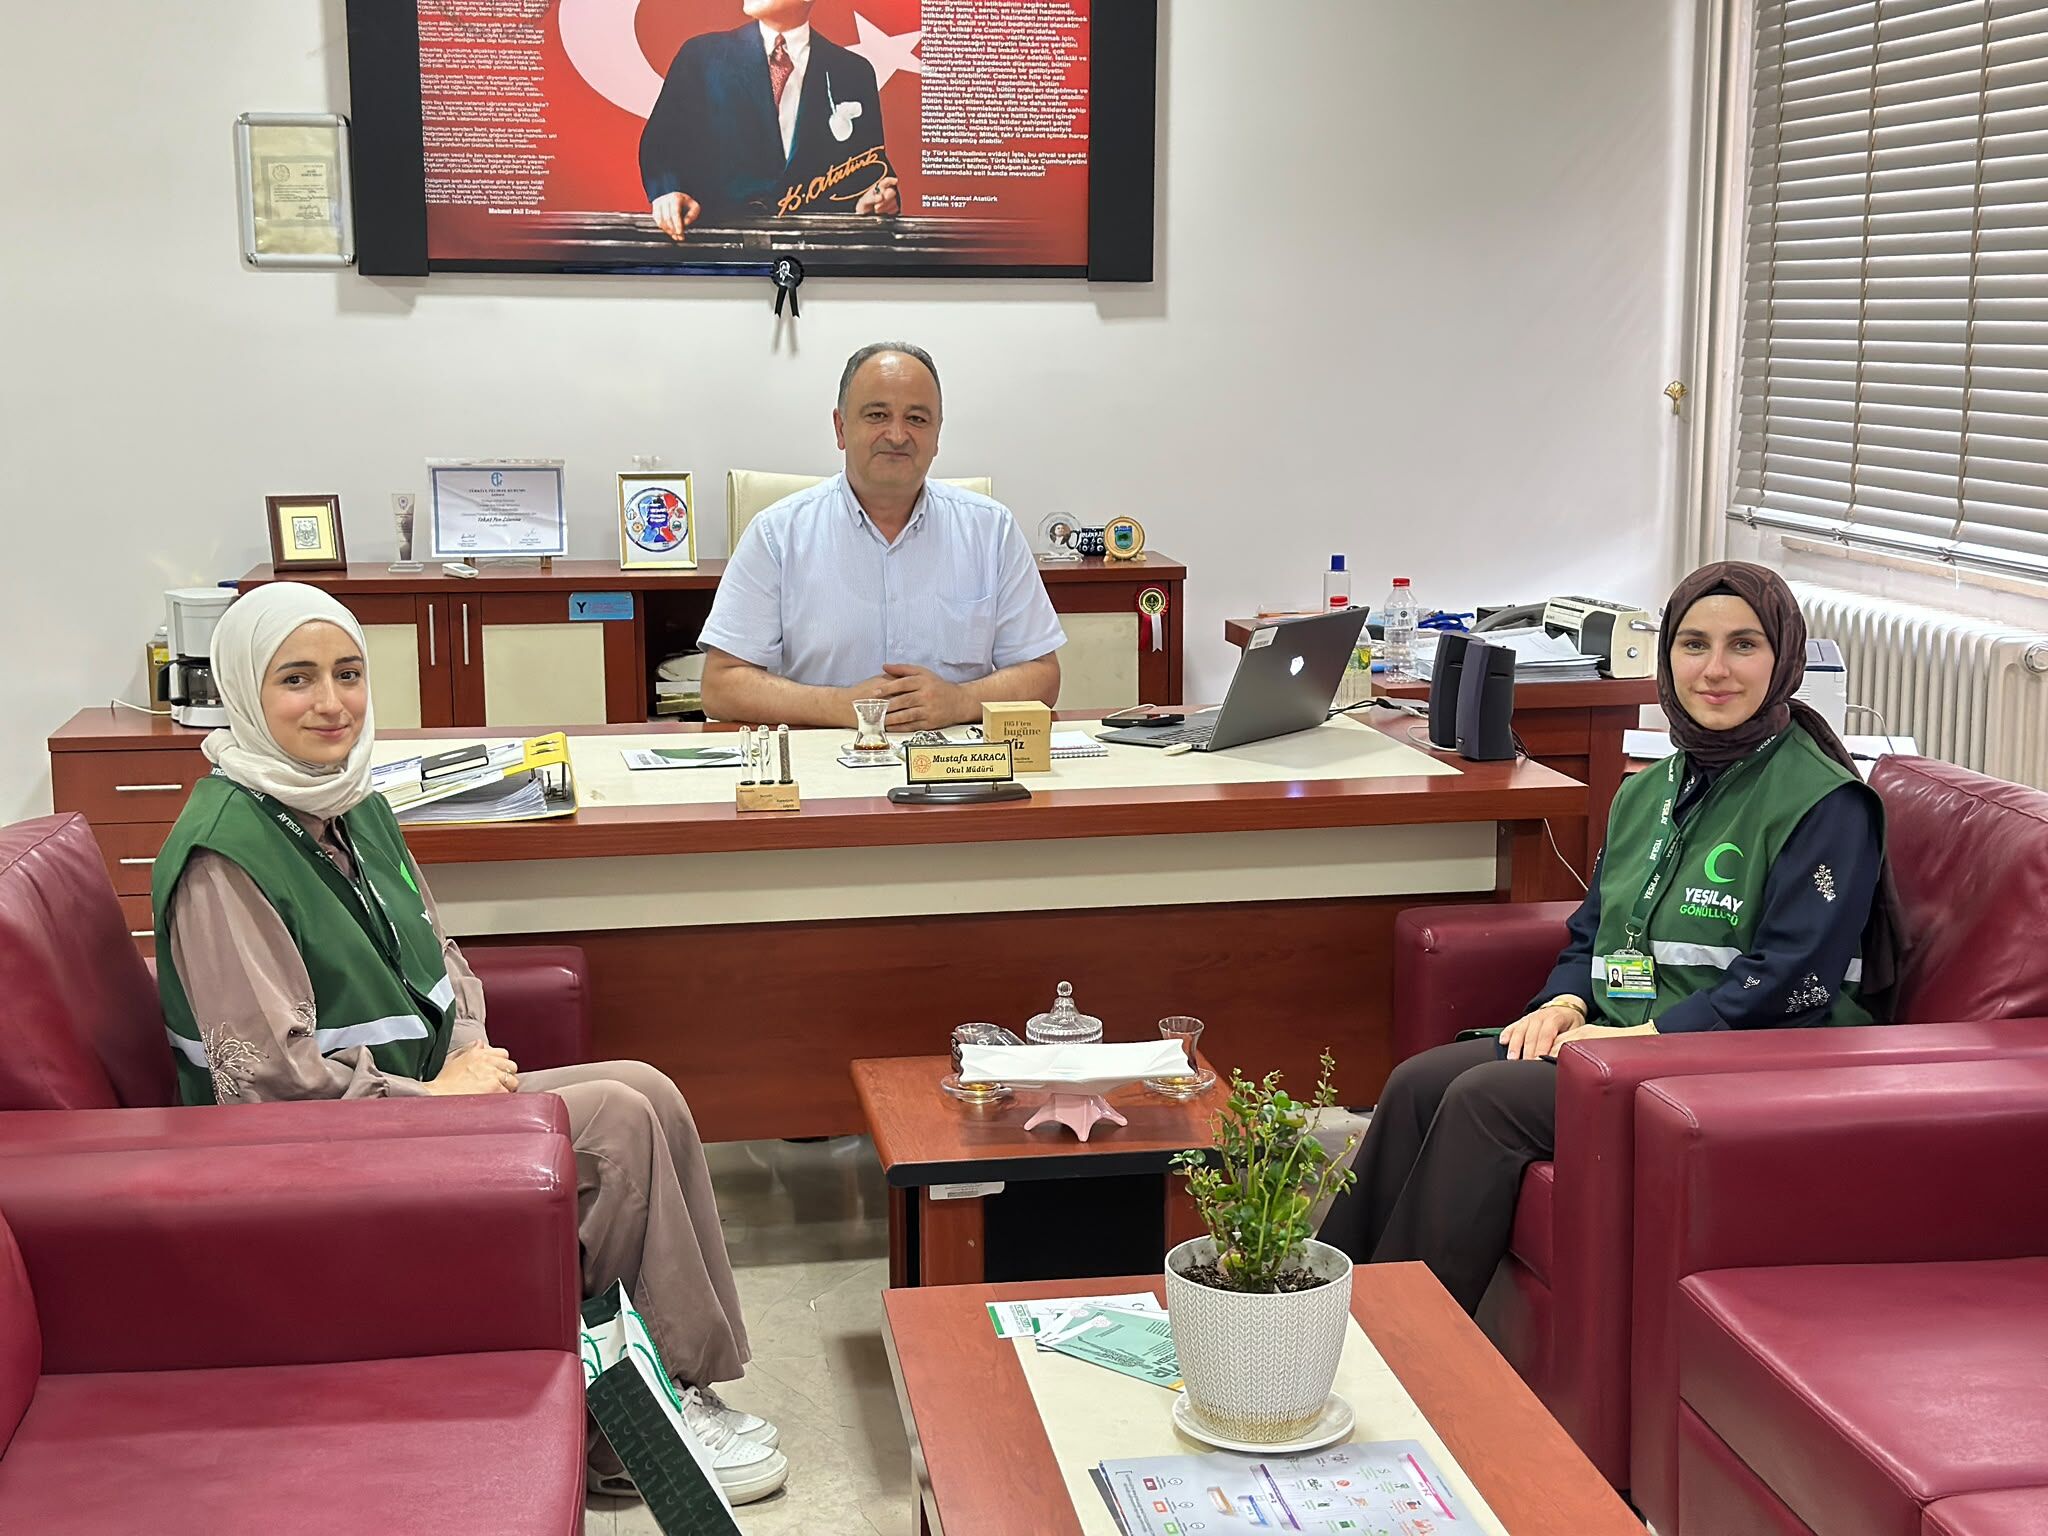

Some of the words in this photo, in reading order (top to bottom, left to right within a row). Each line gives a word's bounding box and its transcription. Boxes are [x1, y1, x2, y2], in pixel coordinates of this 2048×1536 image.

[1004, 727, 1041, 737] bugüne
[933, 754, 968, 764] Mustafa
[970, 753, 1006, 762] KARACA
[966, 765, 994, 773] Müdürü
[1685, 887, 1744, 913] YEŞİLAY
